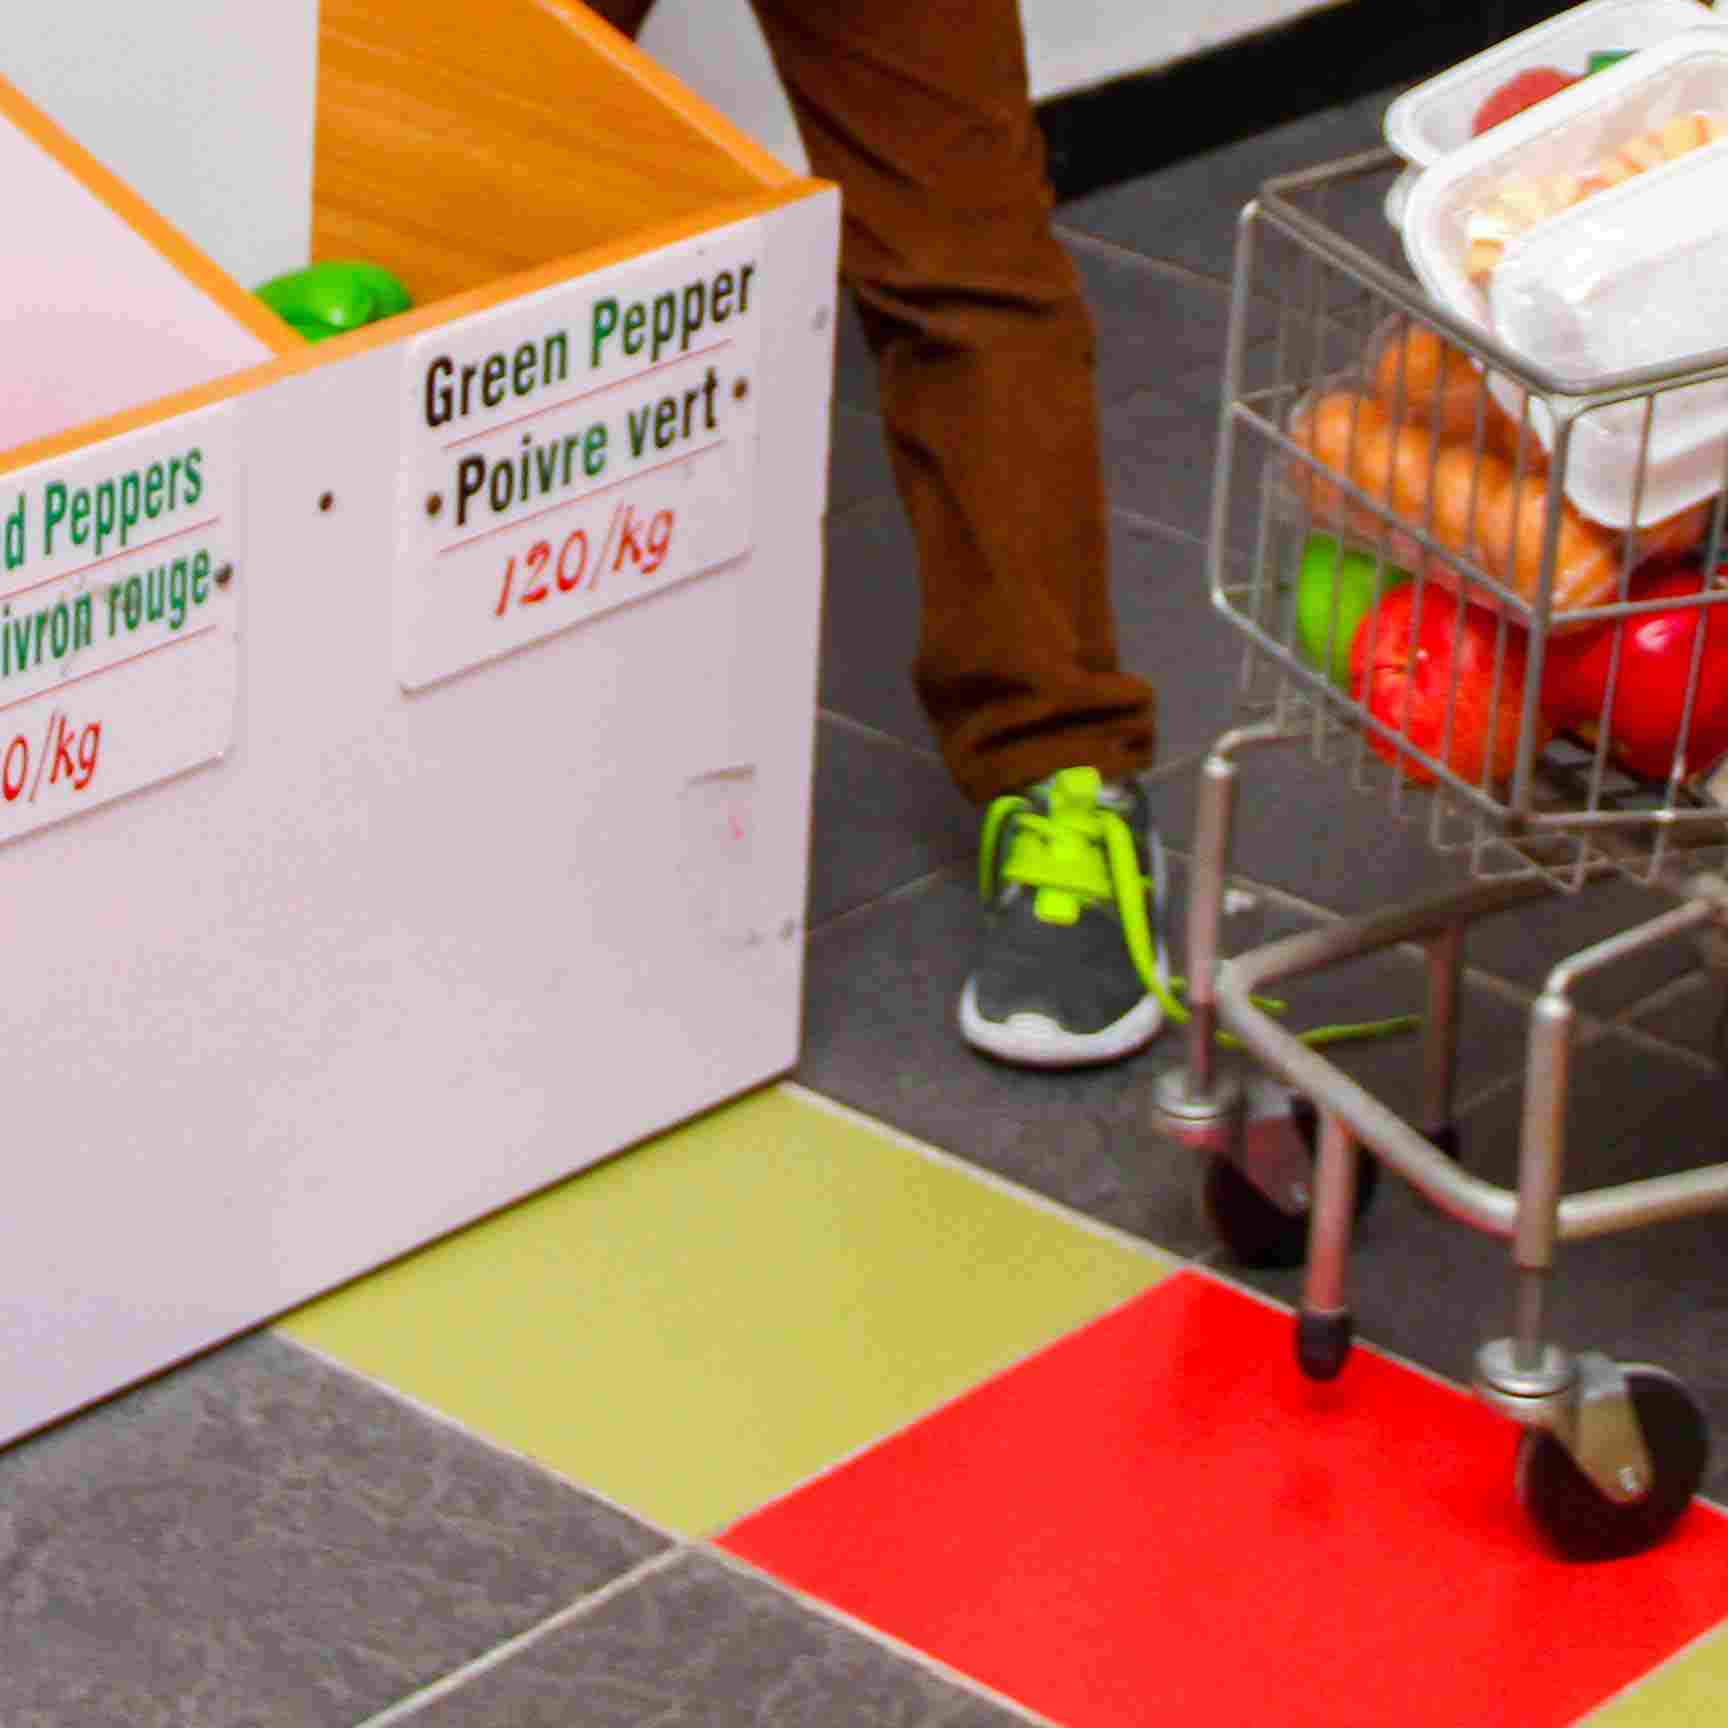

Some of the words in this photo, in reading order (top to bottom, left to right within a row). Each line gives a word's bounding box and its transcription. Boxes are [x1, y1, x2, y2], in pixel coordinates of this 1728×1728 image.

[425, 329, 568, 428] Green
[590, 261, 755, 368] Pepper
[44, 446, 203, 556] Peppers
[456, 421, 608, 527] Poivre
[627, 366, 719, 459] vert
[108, 548, 213, 638] rouge
[495, 499, 677, 617] 120/kg
